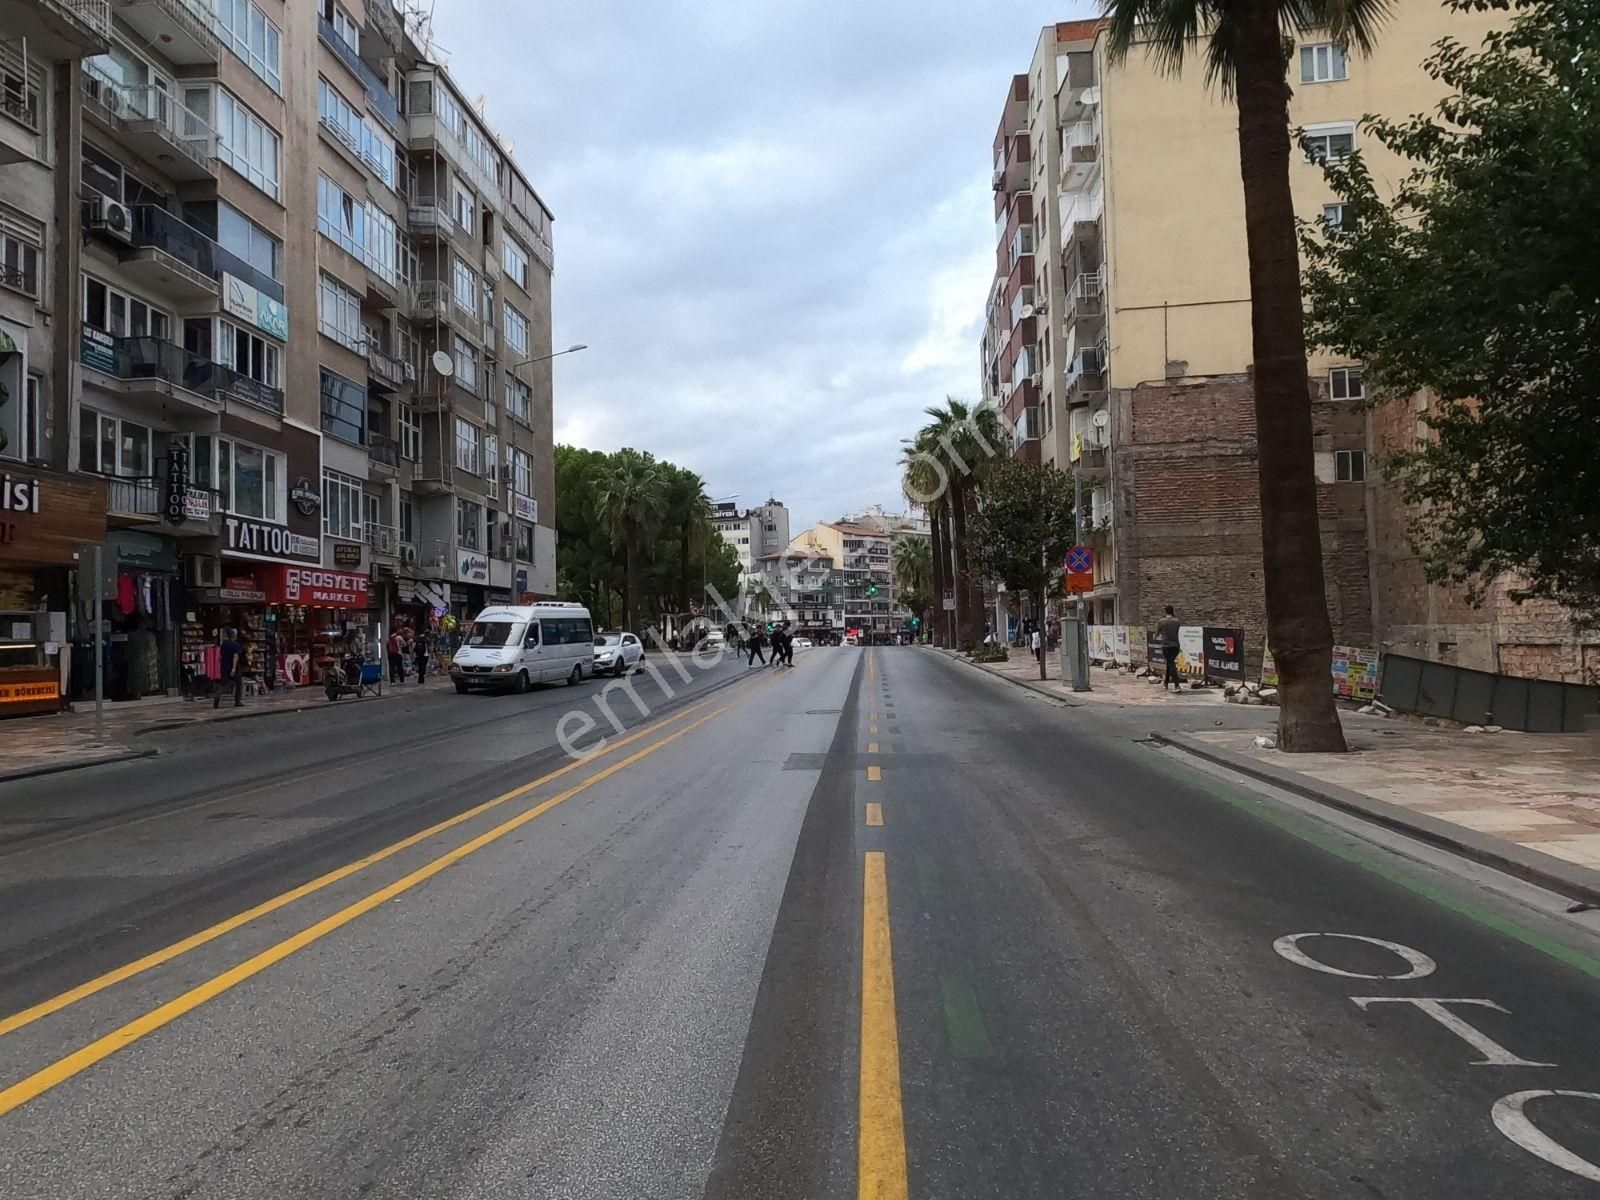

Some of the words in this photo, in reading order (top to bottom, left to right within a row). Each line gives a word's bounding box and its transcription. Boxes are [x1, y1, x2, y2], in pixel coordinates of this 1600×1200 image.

[169, 451, 180, 515] TATTOO
[226, 518, 292, 555] TATTOO
[301, 571, 368, 592] SOSYETE
[313, 591, 357, 603] MARKET
